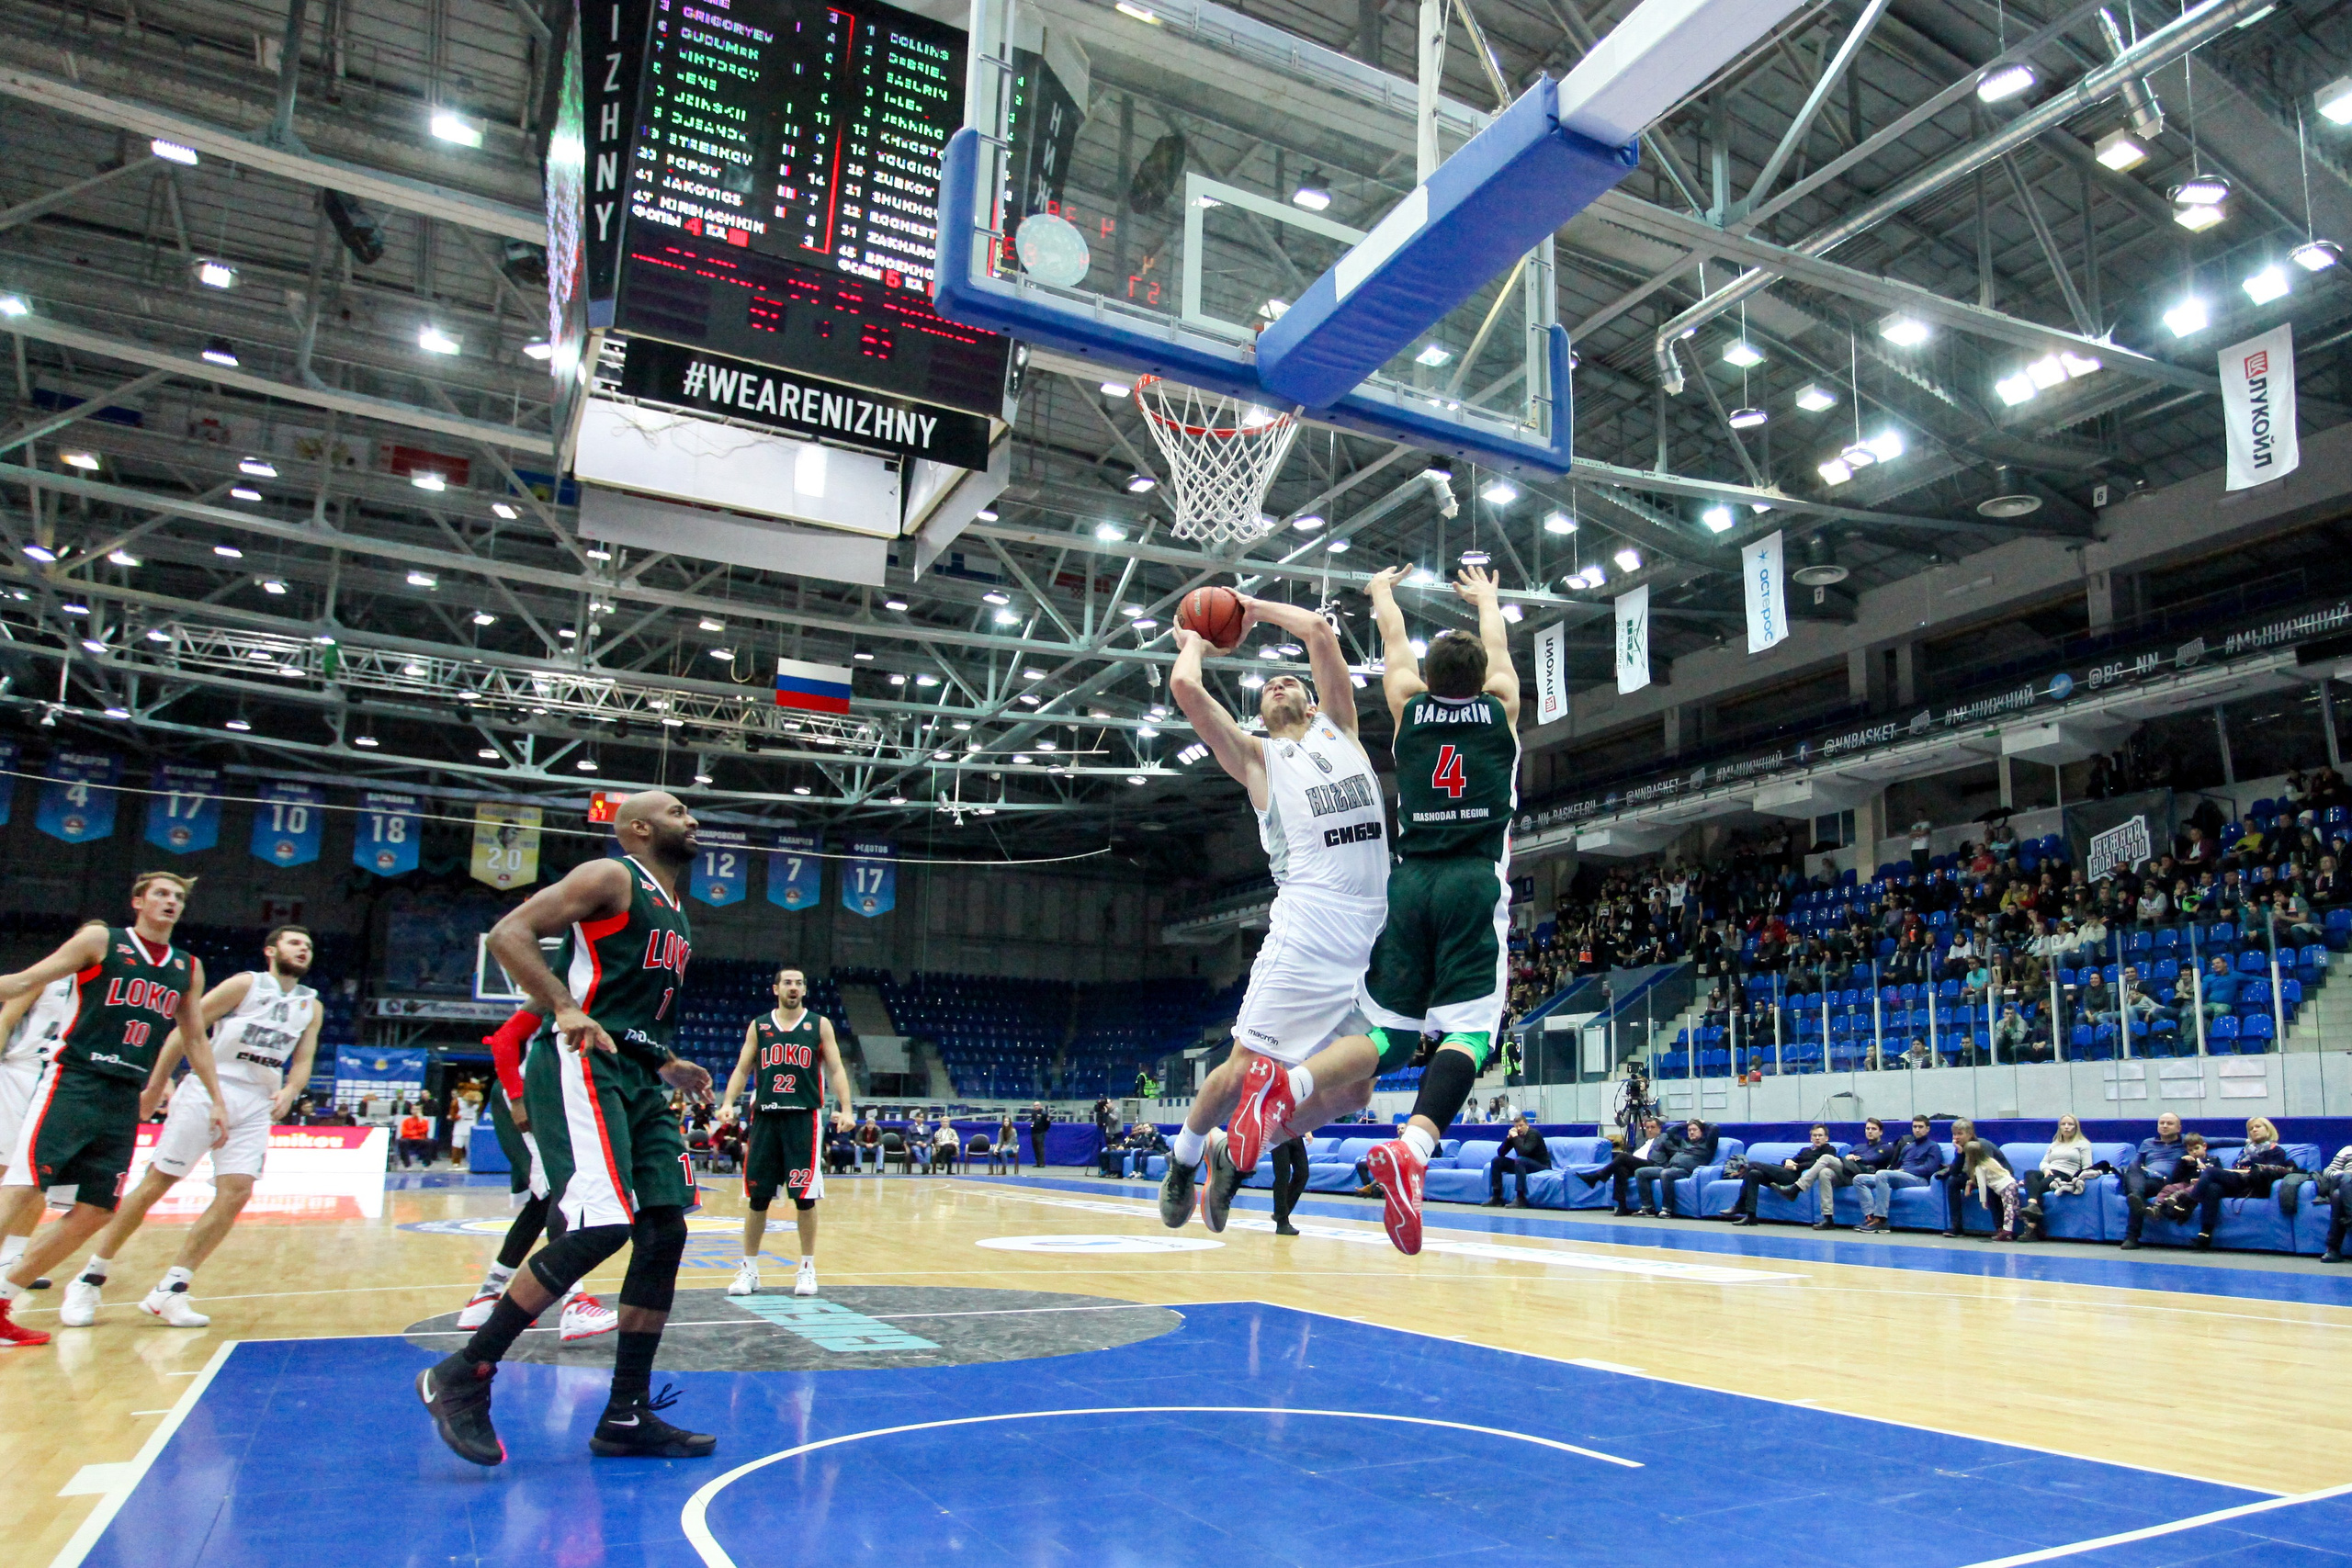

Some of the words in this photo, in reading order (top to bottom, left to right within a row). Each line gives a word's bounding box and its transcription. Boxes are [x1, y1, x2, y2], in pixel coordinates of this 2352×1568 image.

[684, 361, 937, 448] #WEARENIZHNY
[2248, 377, 2276, 468] ЛУКОЙЛ
[1544, 637, 1555, 695] ЛУКОЙЛ
[1414, 704, 1492, 725] BABURIN
[1309, 751, 1333, 773] 6
[1432, 744, 1466, 798] 4
[66, 779, 88, 807] 4
[166, 790, 207, 818] 17
[272, 804, 308, 834] 10
[1461, 808, 1488, 819] REGION
[371, 815, 406, 843] 18
[705, 852, 735, 878] 12
[787, 858, 802, 882] 7
[855, 867, 884, 895] 17
[643, 929, 692, 987] LOK
[105, 977, 180, 1020] LOKO
[655, 987, 673, 1021] 1
[122, 1020, 152, 1047] 10
[1248, 1027, 1279, 1046] macron
[761, 1043, 812, 1069] LOKO
[773, 1074, 797, 1093] 22
[788, 1169, 812, 1189] 22
